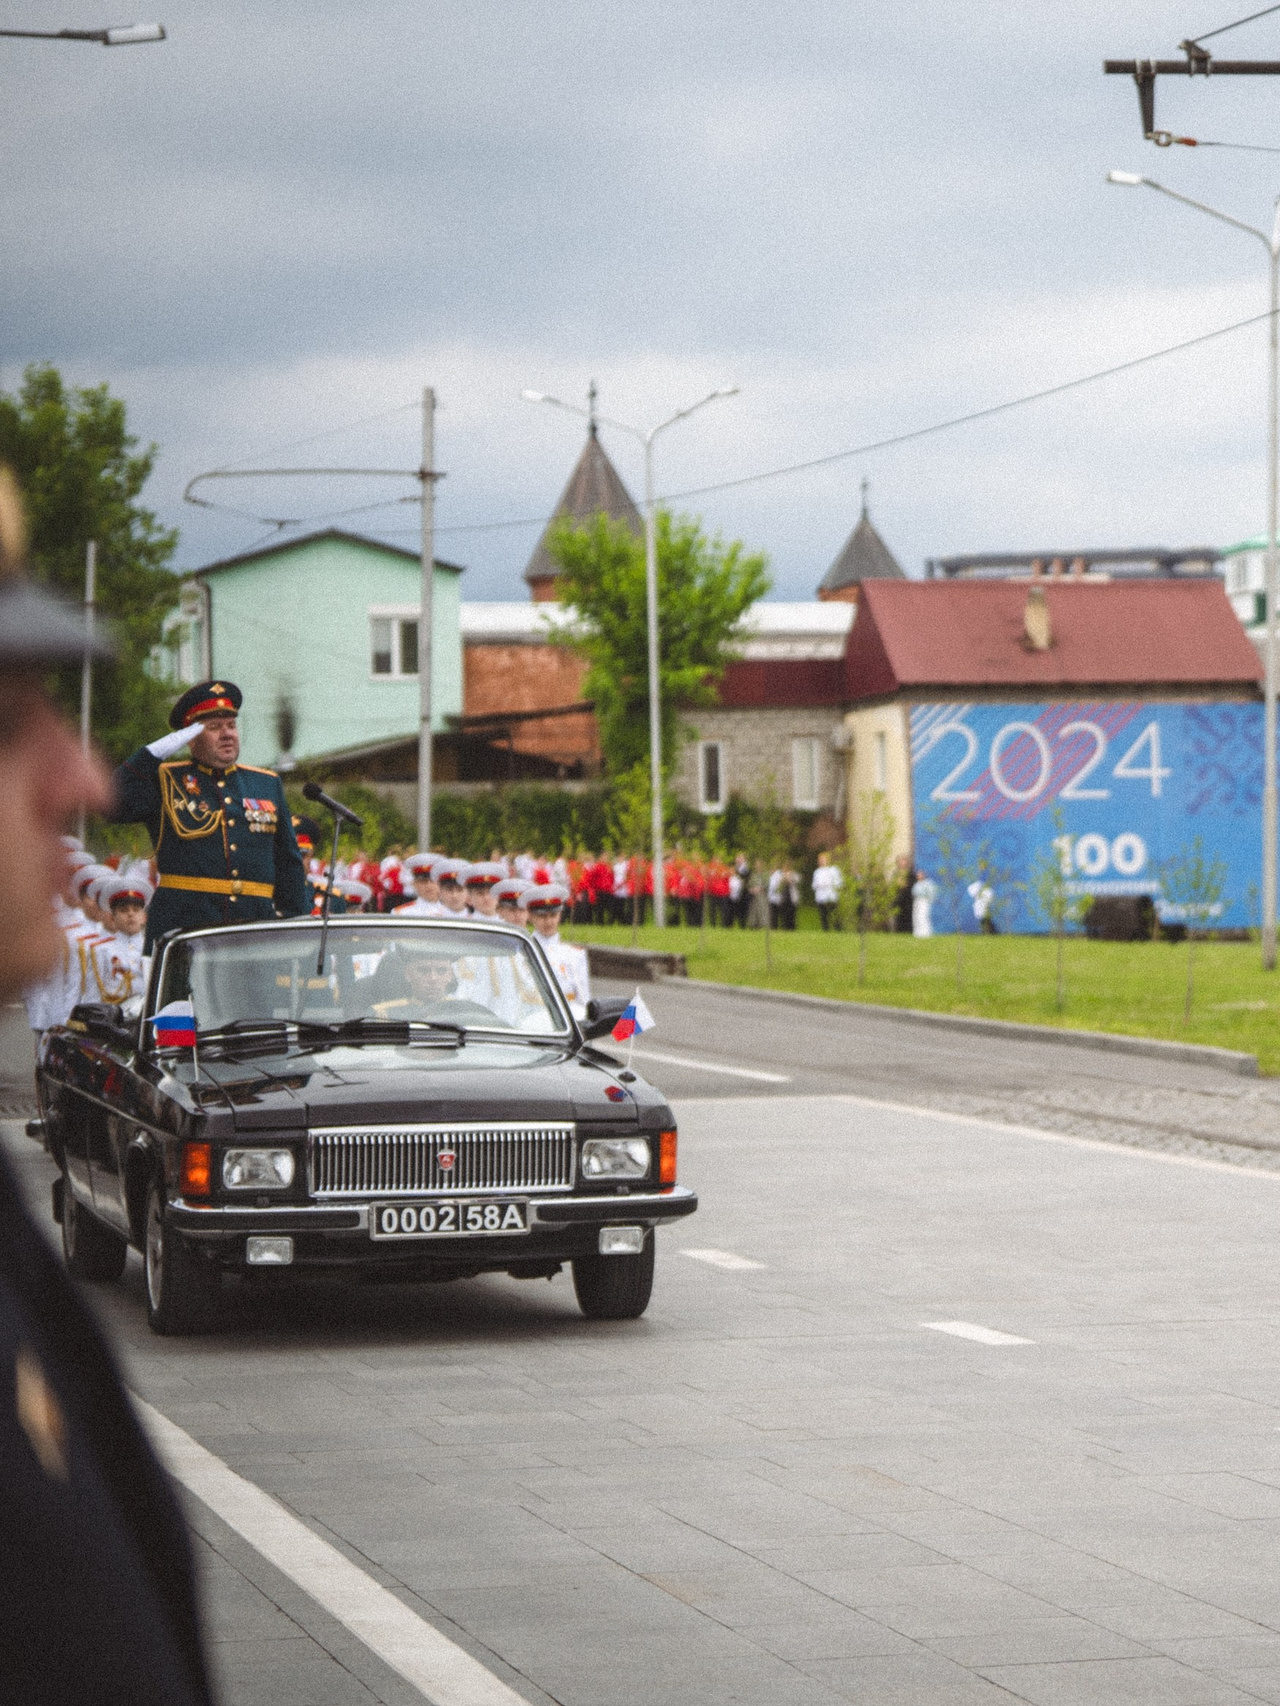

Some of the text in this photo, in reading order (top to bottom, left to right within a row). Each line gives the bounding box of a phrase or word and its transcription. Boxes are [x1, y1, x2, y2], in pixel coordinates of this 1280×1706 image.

[930, 720, 1172, 801] 2024
[1052, 832, 1147, 876] 100
[381, 1204, 524, 1233] 0002 58А
